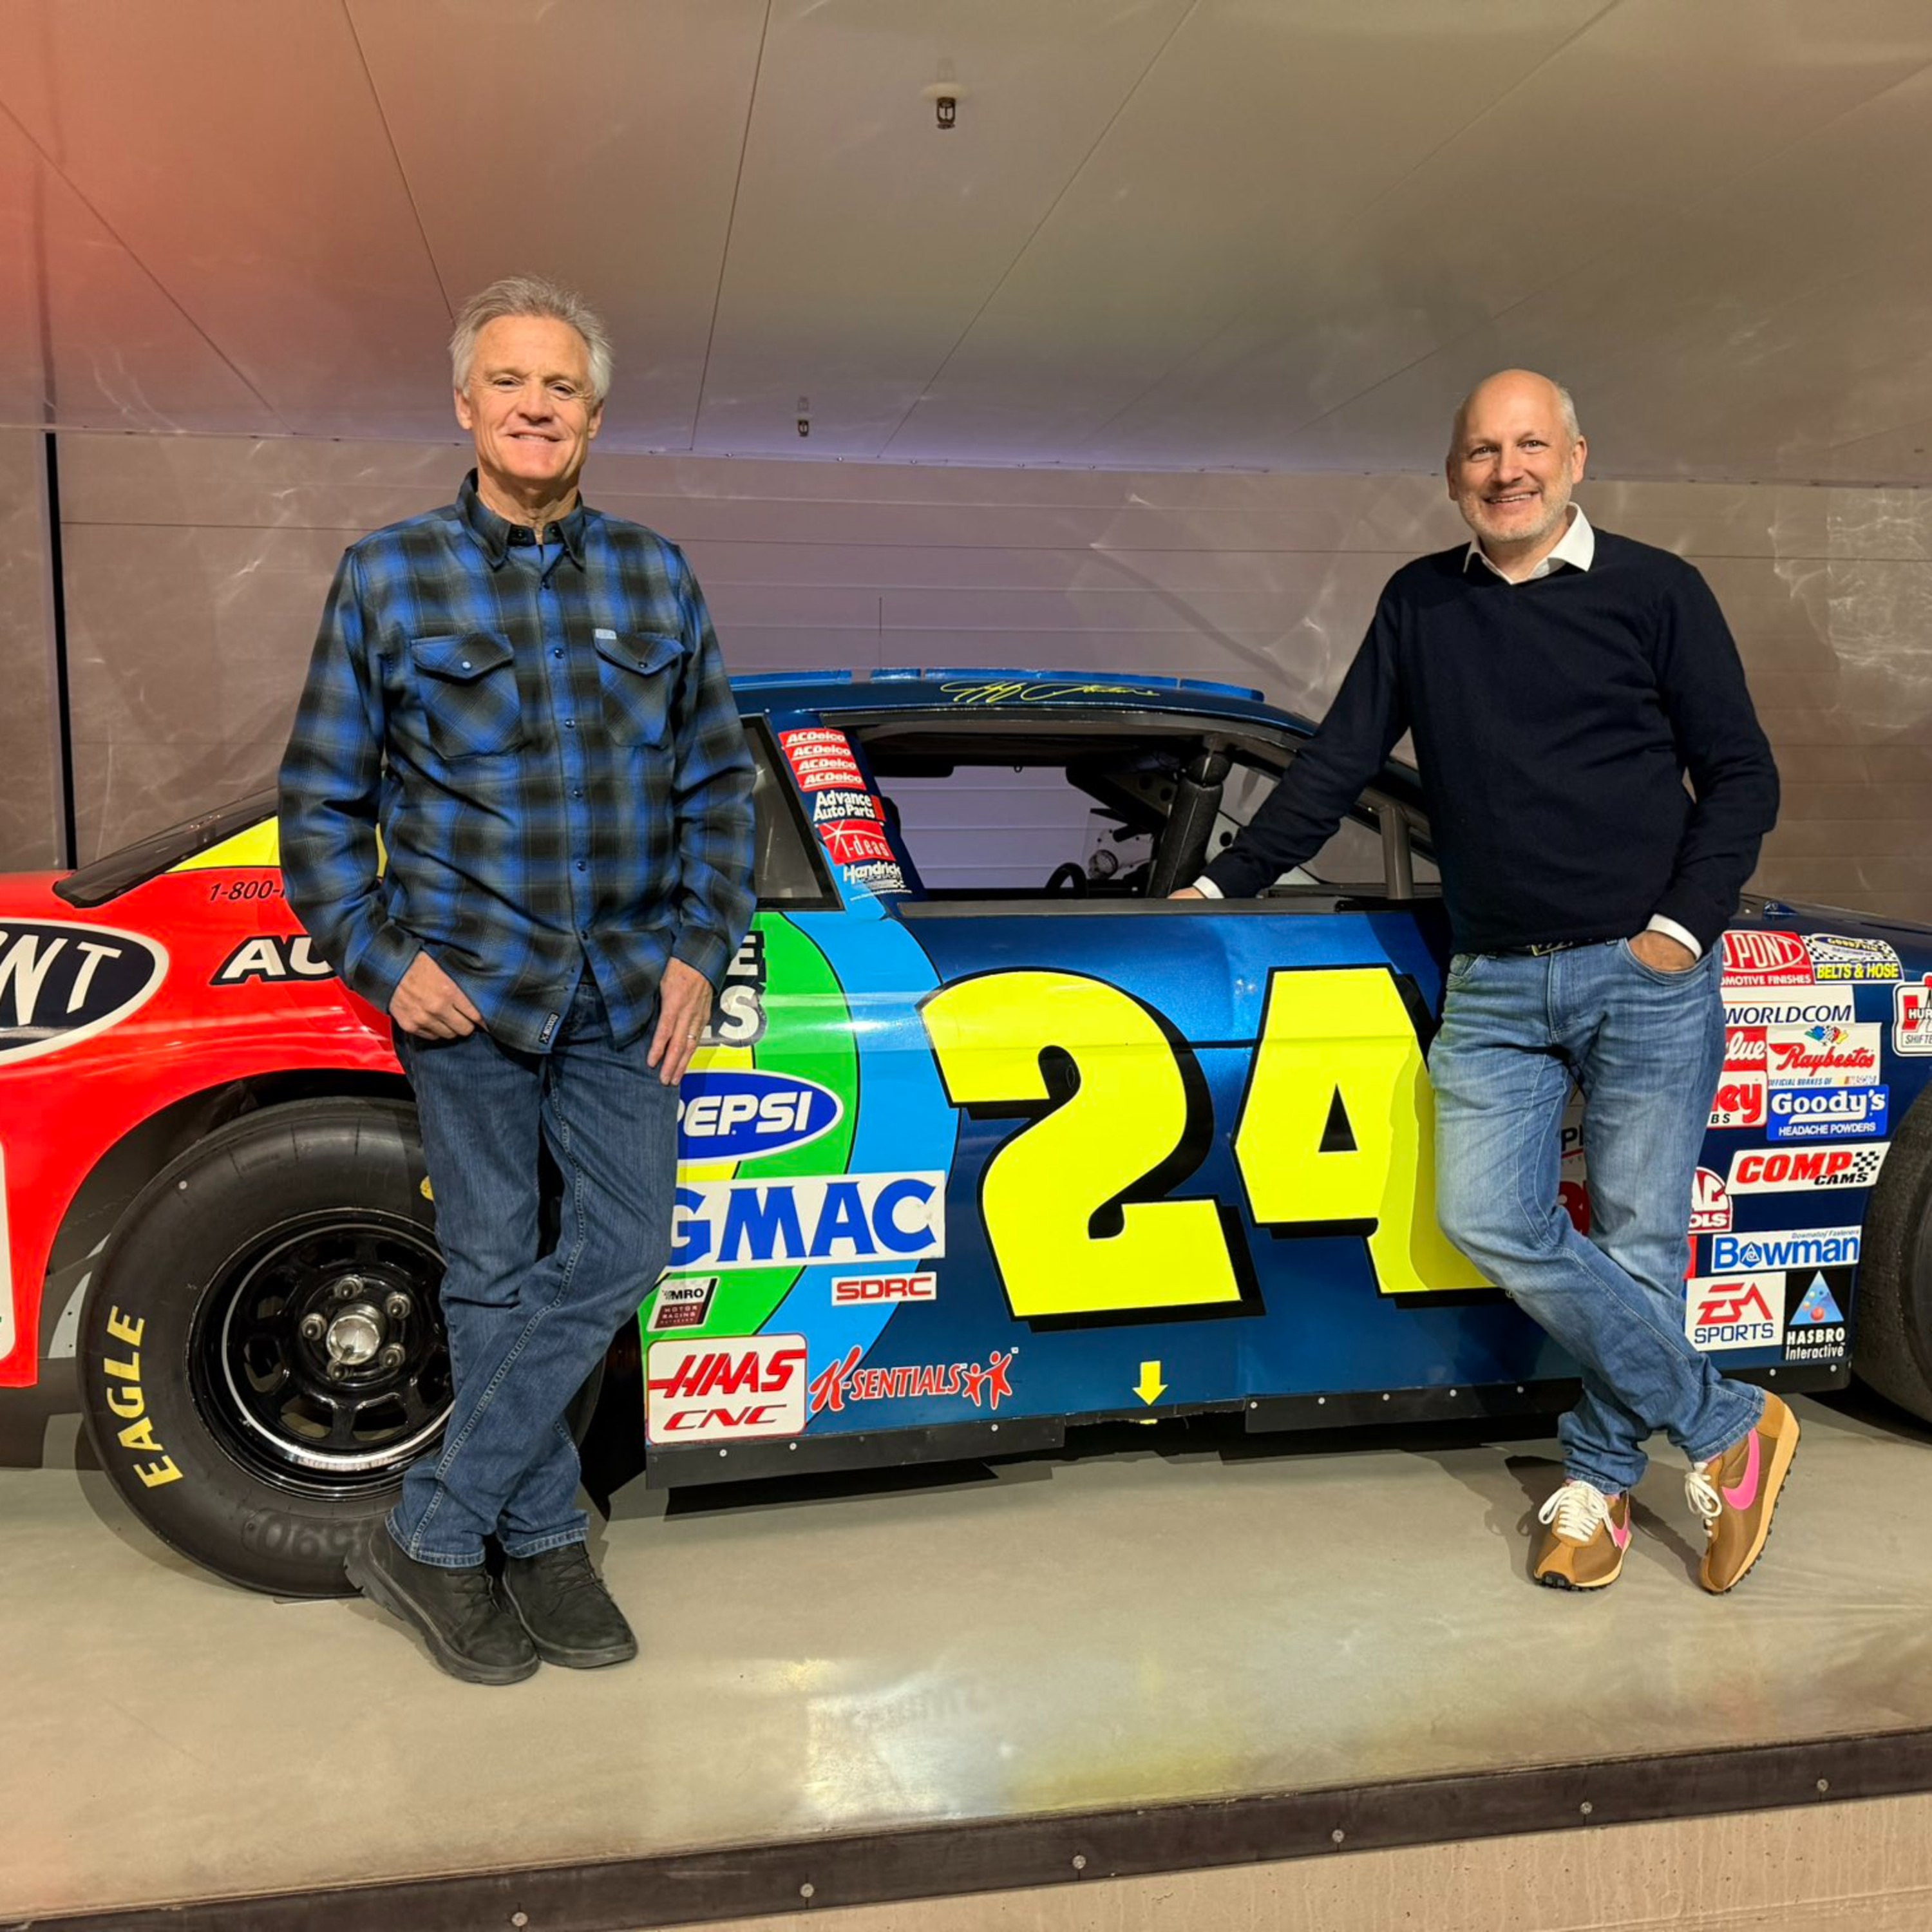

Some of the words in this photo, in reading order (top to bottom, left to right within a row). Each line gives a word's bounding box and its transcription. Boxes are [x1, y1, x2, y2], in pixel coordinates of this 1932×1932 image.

[787, 732, 846, 743] ACDelco
[793, 744, 851, 756] ACDelco
[799, 758, 857, 770] ACDelco
[804, 772, 863, 784] ACDelco
[816, 790, 873, 806] Advance
[813, 806, 845, 821] Auto
[846, 804, 876, 819] Parts
[1768, 974, 1812, 985] FINISHES
[1817, 963, 1852, 980] BELTS
[1853, 962, 1864, 979] &
[1867, 961, 1899, 979] HOSE
[1725, 1030, 1766, 1061] lue
[1768, 1042, 1876, 1077] Raybestos
[1771, 1088, 1886, 1123] Goody's
[1778, 1124, 1829, 1137] HEADACHE
[1830, 1121, 1876, 1134] POWDERS
[920, 966, 1504, 1320] 24
[1735, 1151, 1853, 1184] COMP
[1814, 1172, 1869, 1186] CAMS
[671, 1287, 705, 1300] MRO
[837, 1276, 933, 1301] SDRC
[1694, 1322, 1774, 1345] SPORTS
[1786, 1327, 1845, 1346] HASBRO
[1785, 1343, 1844, 1361] Interactive
[650, 1350, 806, 1399] HAAS
[103, 1305, 183, 1488] EAGLE
[663, 1404, 788, 1431] CNC
